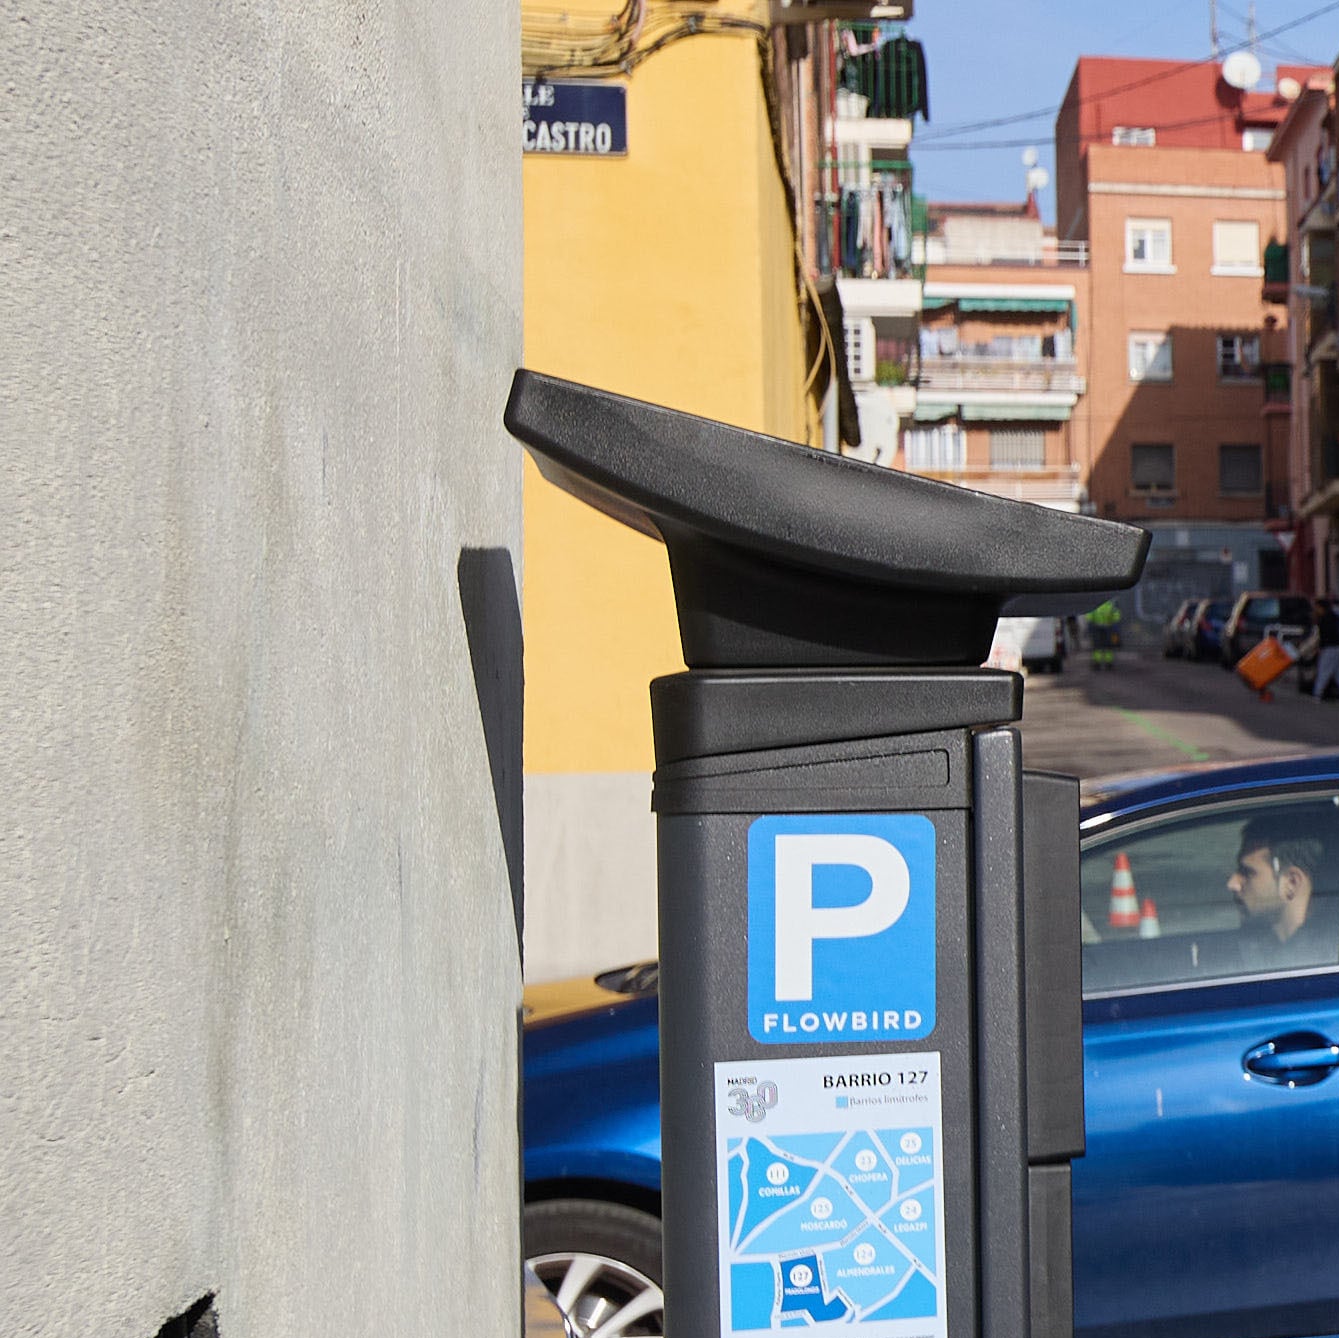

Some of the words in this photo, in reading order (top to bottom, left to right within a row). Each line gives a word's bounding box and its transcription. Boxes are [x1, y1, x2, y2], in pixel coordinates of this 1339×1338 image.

[522, 119, 612, 154] CASTRO
[775, 833, 911, 1002] P
[763, 1009, 922, 1034] FLOWBIRD
[727, 1075, 758, 1086] MADRID
[823, 1072, 892, 1089] BARRIO
[898, 1070, 929, 1086] 127
[849, 1096, 882, 1107] Barrios
[895, 1156, 931, 1167] DELICIAS
[770, 1168, 786, 1179] 111
[848, 1173, 888, 1184] CHOPERA
[758, 1185, 800, 1198] COMILLAS
[893, 1222, 928, 1233] LEGAZPI
[836, 1265, 896, 1279] ALMENDRALES
